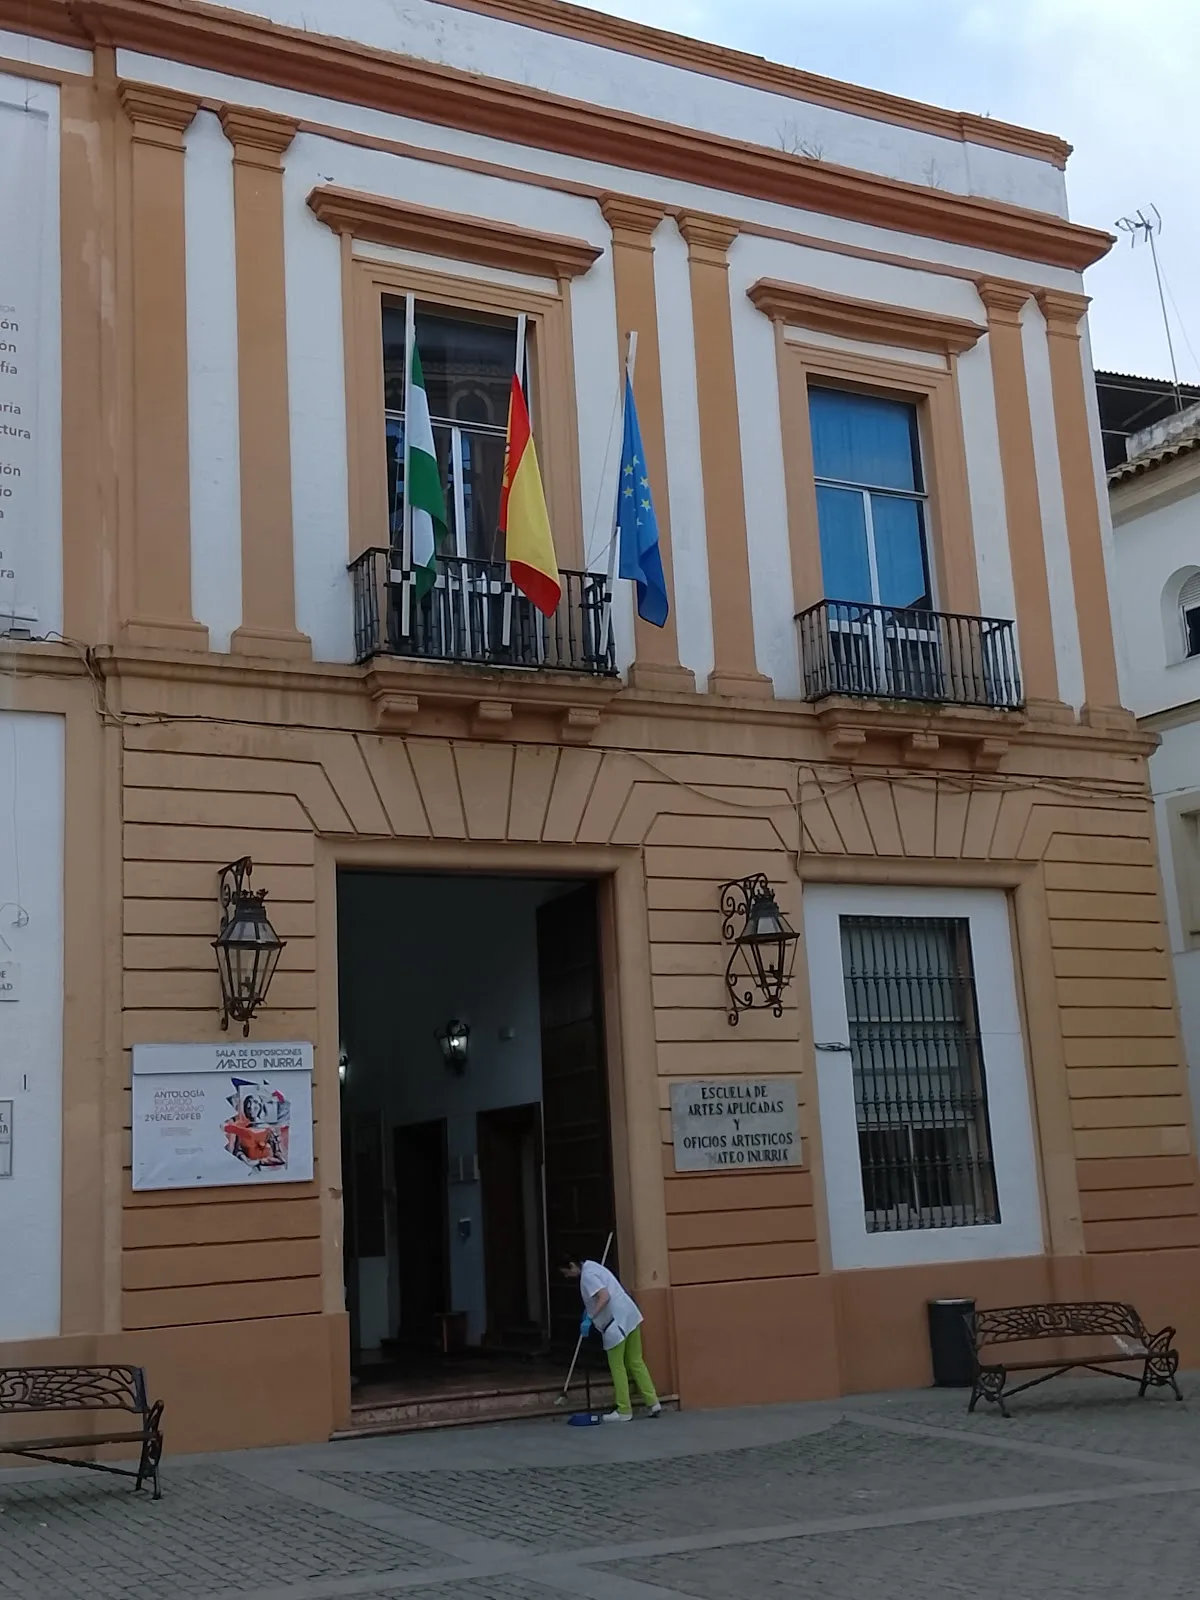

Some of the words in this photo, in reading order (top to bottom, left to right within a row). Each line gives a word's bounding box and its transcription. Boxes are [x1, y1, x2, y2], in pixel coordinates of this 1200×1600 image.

[215, 1049, 237, 1058] SALA
[239, 1049, 248, 1057] DE
[250, 1048, 302, 1057] EXPOSICIONES
[215, 1058, 257, 1069] MATEO
[263, 1057, 303, 1068] INURRIA
[701, 1085, 752, 1100] ESCUELA
[754, 1085, 768, 1098] DE
[688, 1103, 723, 1116] ARTES
[727, 1101, 784, 1115] APLICADAS
[733, 1118, 740, 1131] Y
[683, 1135, 727, 1149] OFICIOS
[731, 1132, 793, 1147] ARTISTICOS
